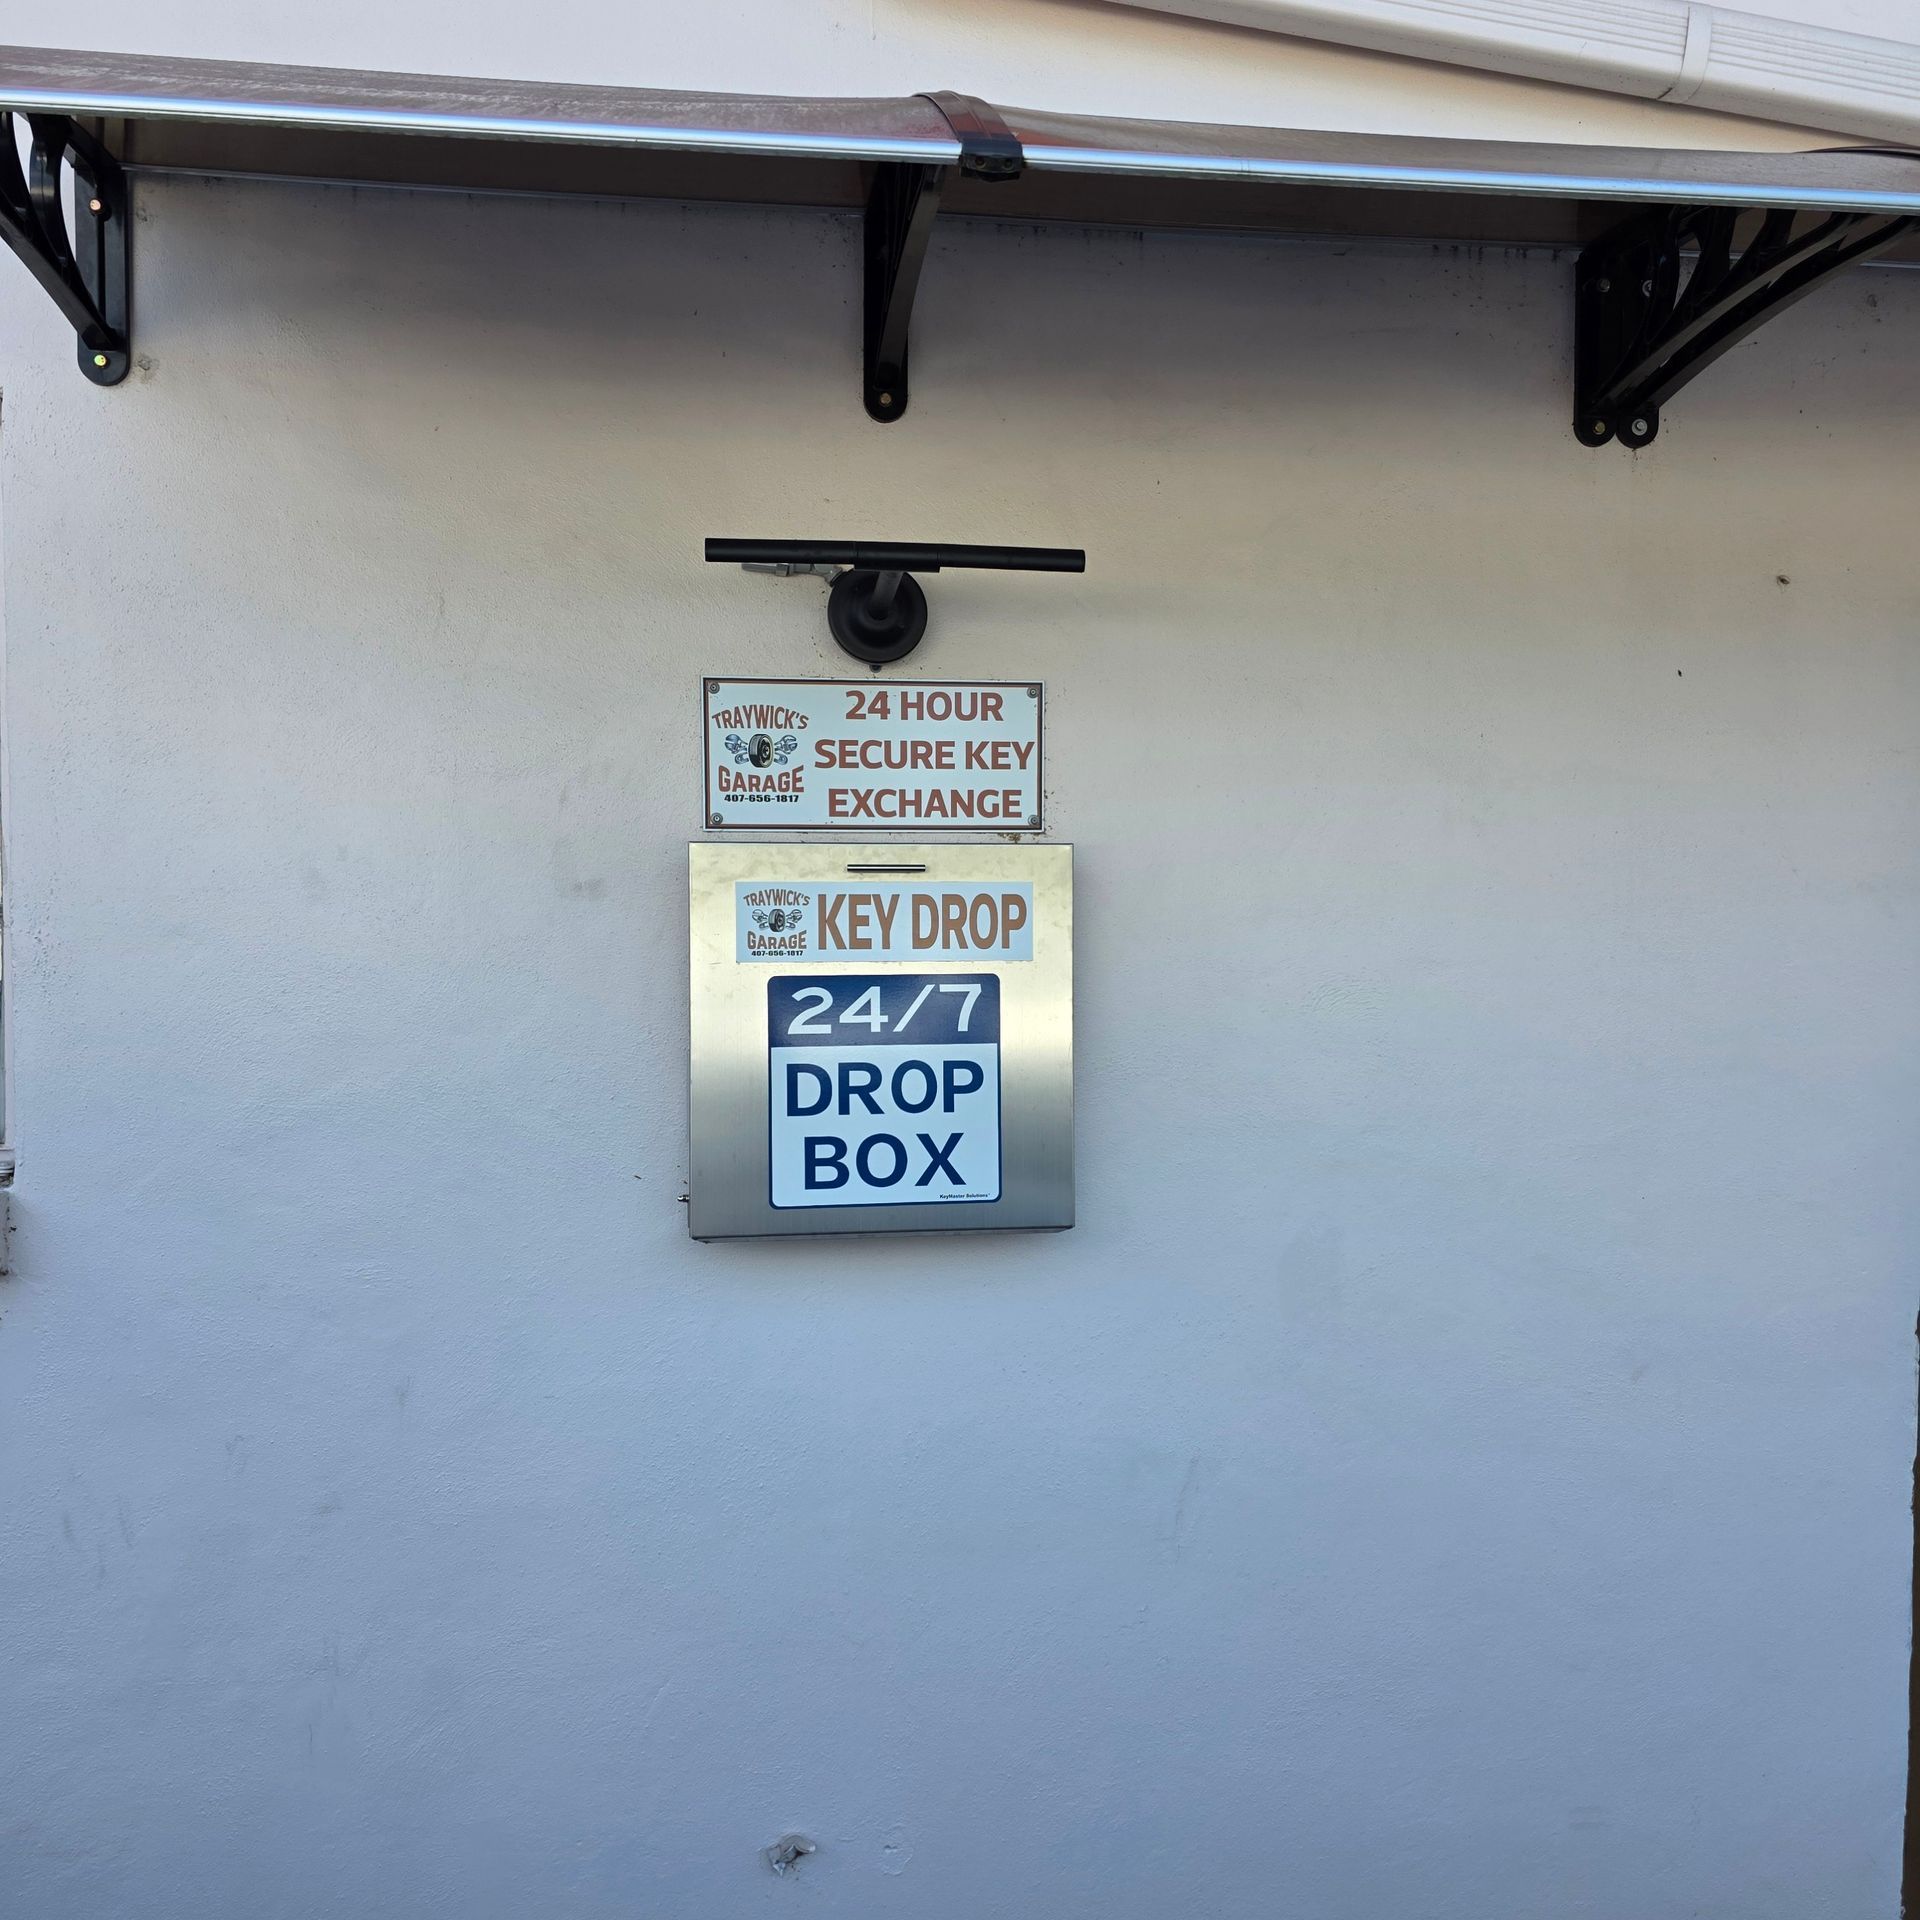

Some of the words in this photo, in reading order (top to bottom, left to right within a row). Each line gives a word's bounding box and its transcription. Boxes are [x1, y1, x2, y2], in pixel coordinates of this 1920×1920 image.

[711, 704, 809, 729] TRAYWICK'S
[845, 690, 891, 721] 24
[900, 691, 1004, 722] HOUR
[814, 739, 955, 770] SECURE
[965, 741, 1035, 770] KEY
[718, 765, 805, 793] GARAGE
[724, 794, 799, 803] 407-656-1817
[828, 788, 1022, 819] EXCHANGE
[743, 888, 811, 906] TRAYWICK'S
[818, 893, 900, 950] KEY
[911, 893, 1027, 950] DROP
[747, 929, 807, 949] GARAGE
[787, 983, 982, 1035] 24/7
[786, 1060, 984, 1117] DROP
[804, 1132, 966, 1190] BOX
